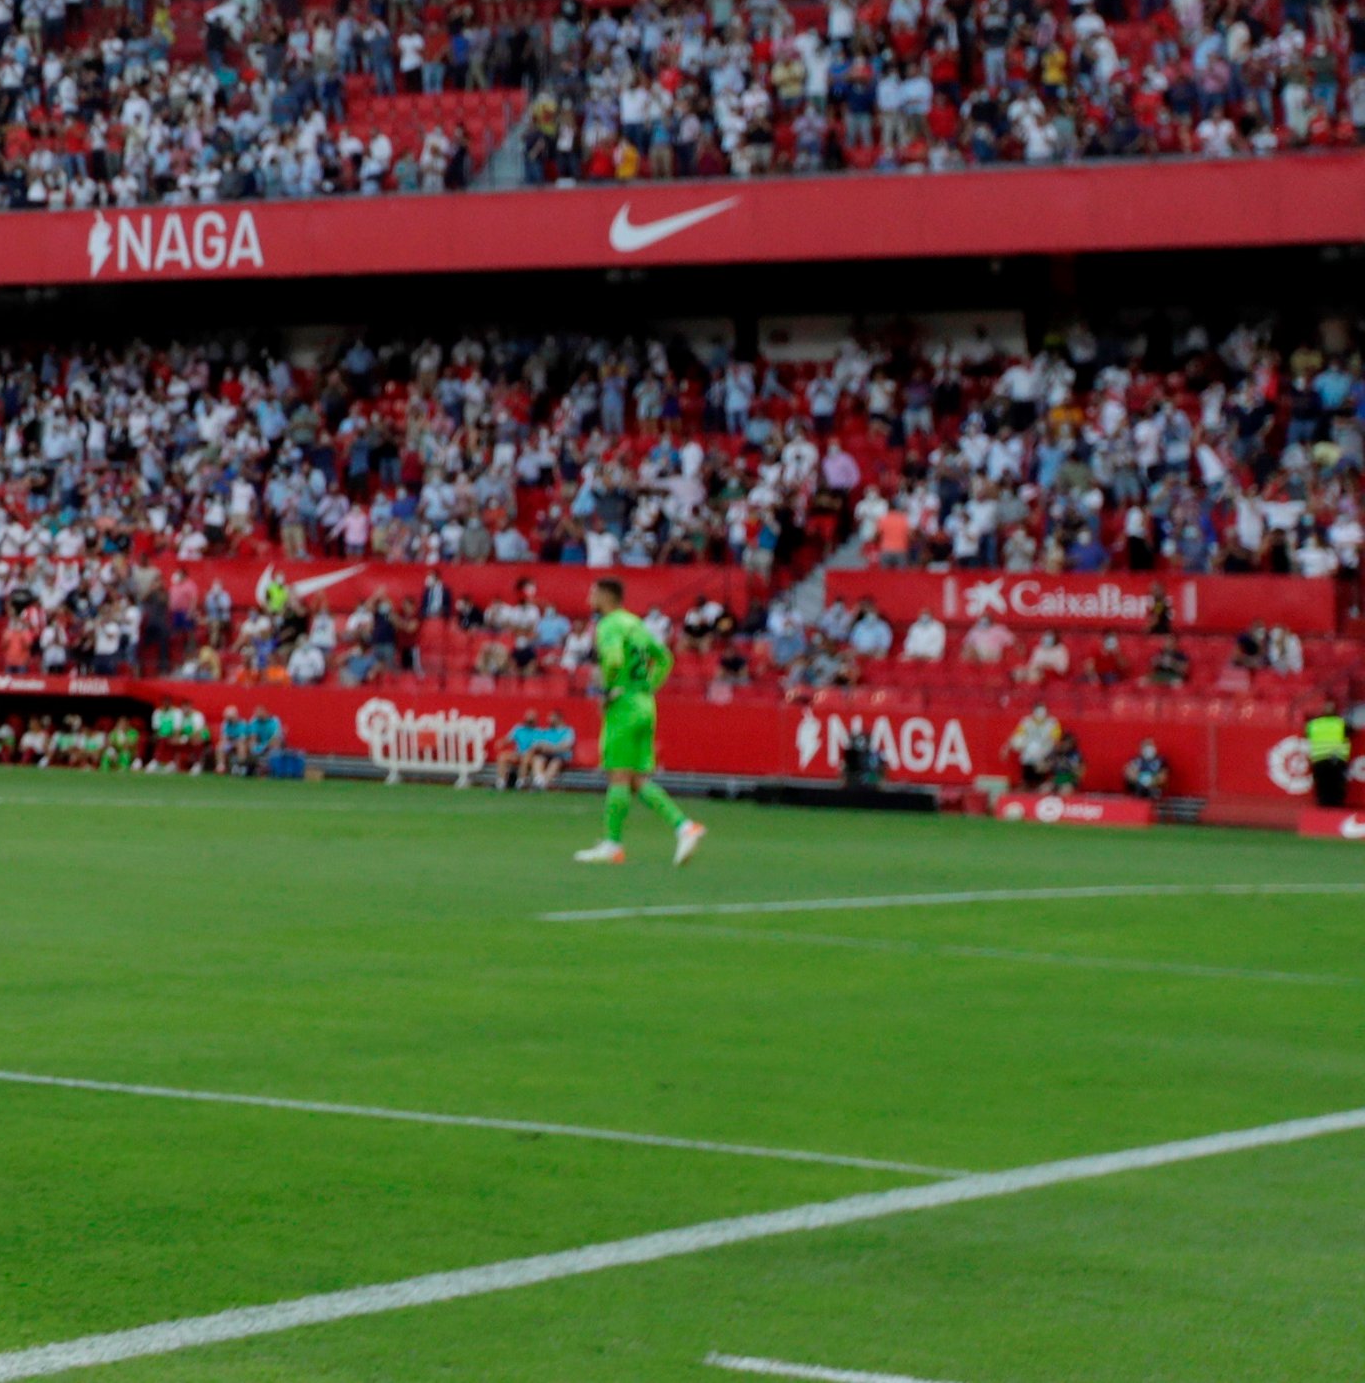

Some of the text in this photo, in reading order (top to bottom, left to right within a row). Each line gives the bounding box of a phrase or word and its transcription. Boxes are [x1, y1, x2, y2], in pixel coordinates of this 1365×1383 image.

[117, 210, 265, 272] NAGA
[1010, 579, 1175, 620] CaixaBan
[827, 713, 973, 774] NAGA
